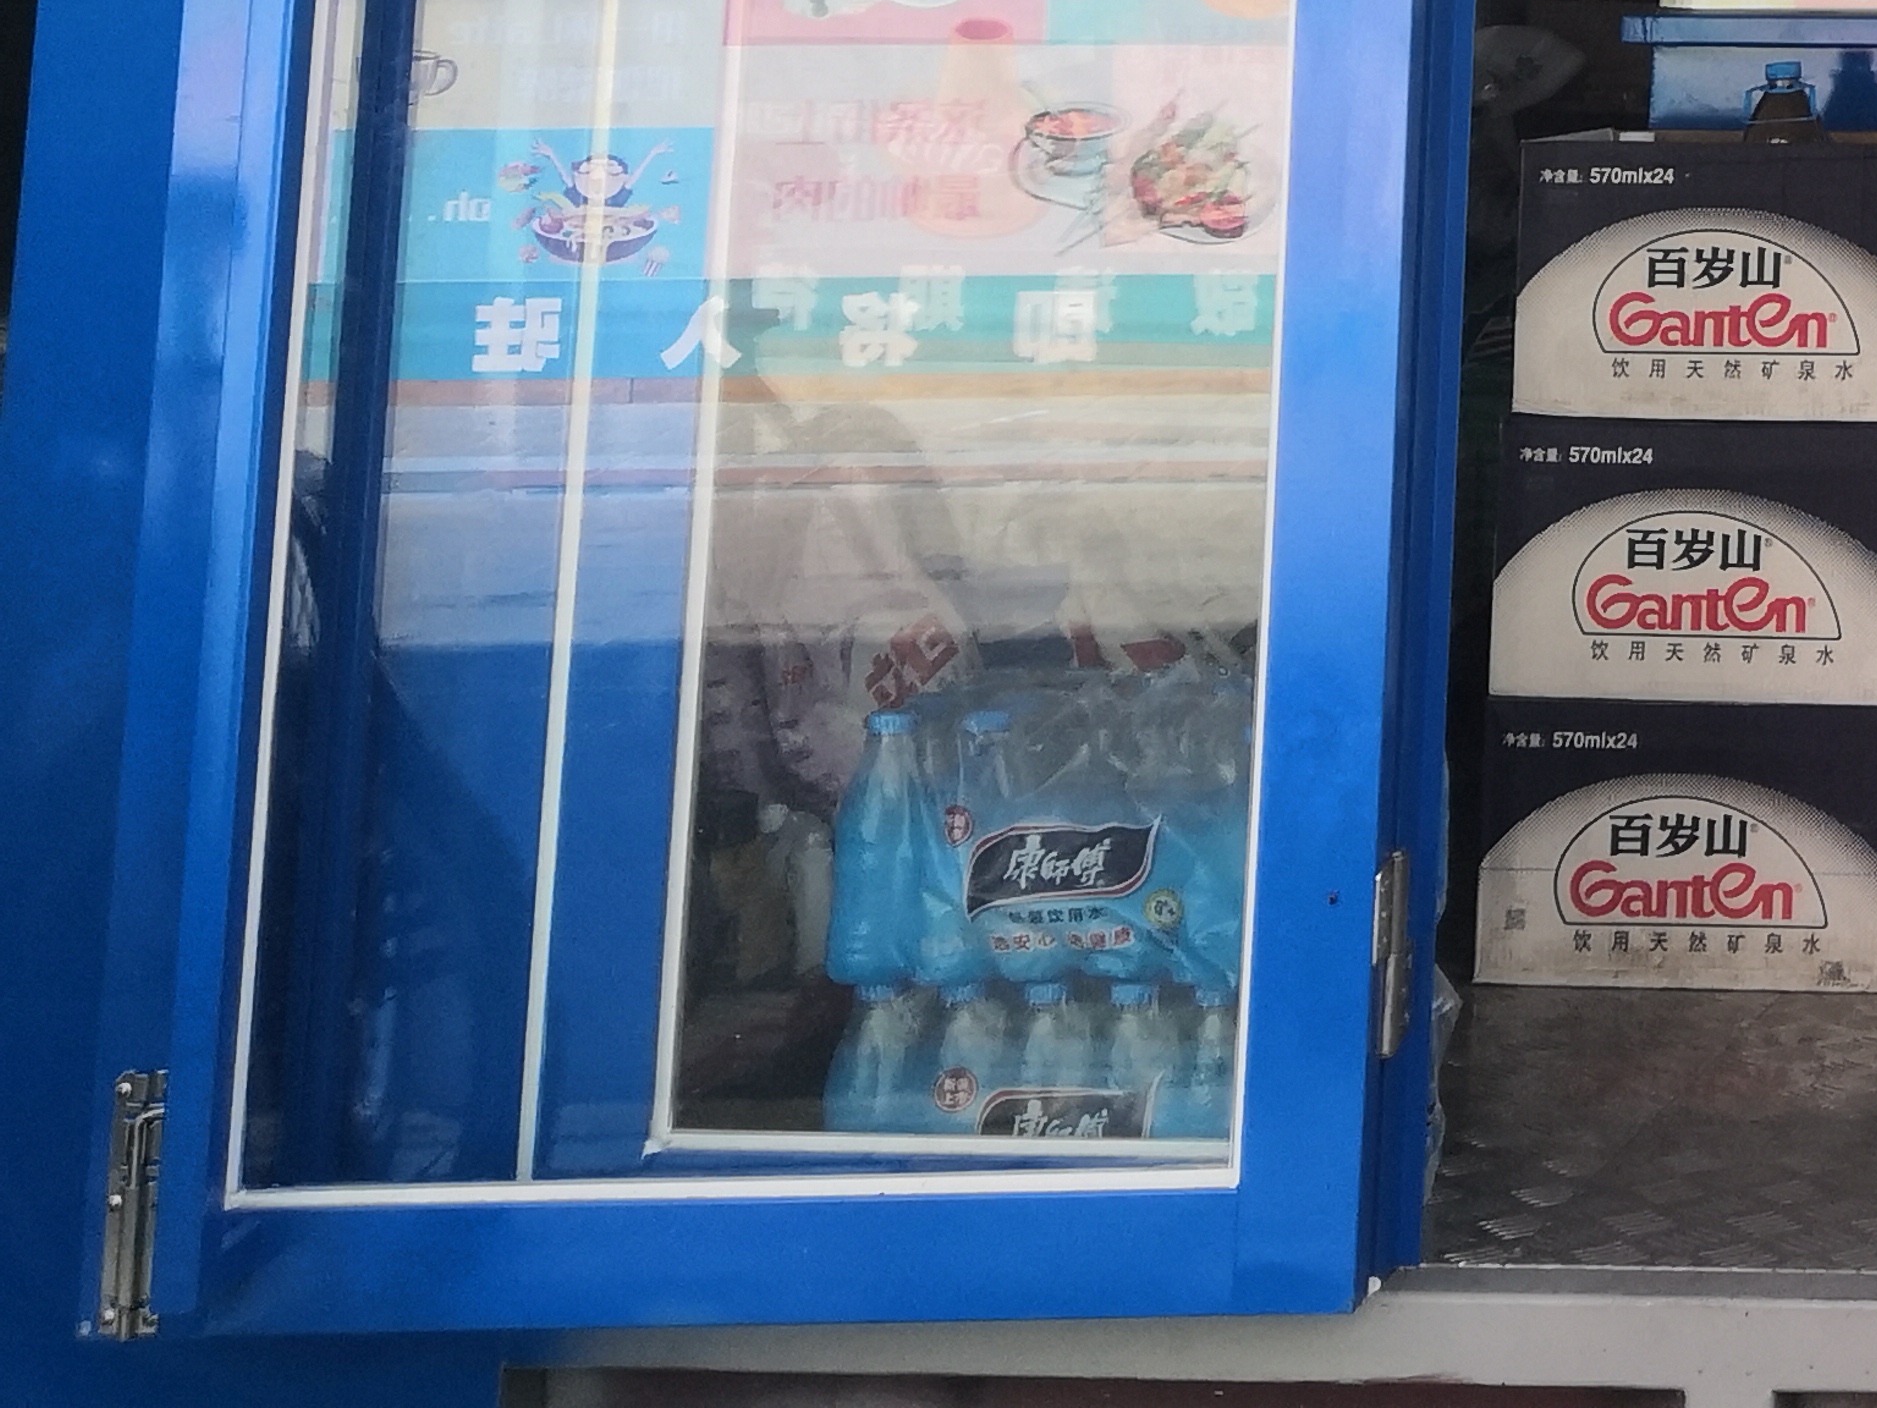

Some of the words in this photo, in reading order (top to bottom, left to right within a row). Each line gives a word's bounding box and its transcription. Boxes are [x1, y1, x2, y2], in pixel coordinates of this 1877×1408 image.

[1646, 245, 1783, 290] 百岁山
[1611, 358, 1854, 381] 饮用天然矿泉水
[1625, 528, 1762, 572] 百岁山
[1590, 639, 1835, 666] 饮用天然矿泉水
[1608, 812, 1748, 859] 百岁山
[1571, 929, 1822, 954] 饮用天然矿泉水
